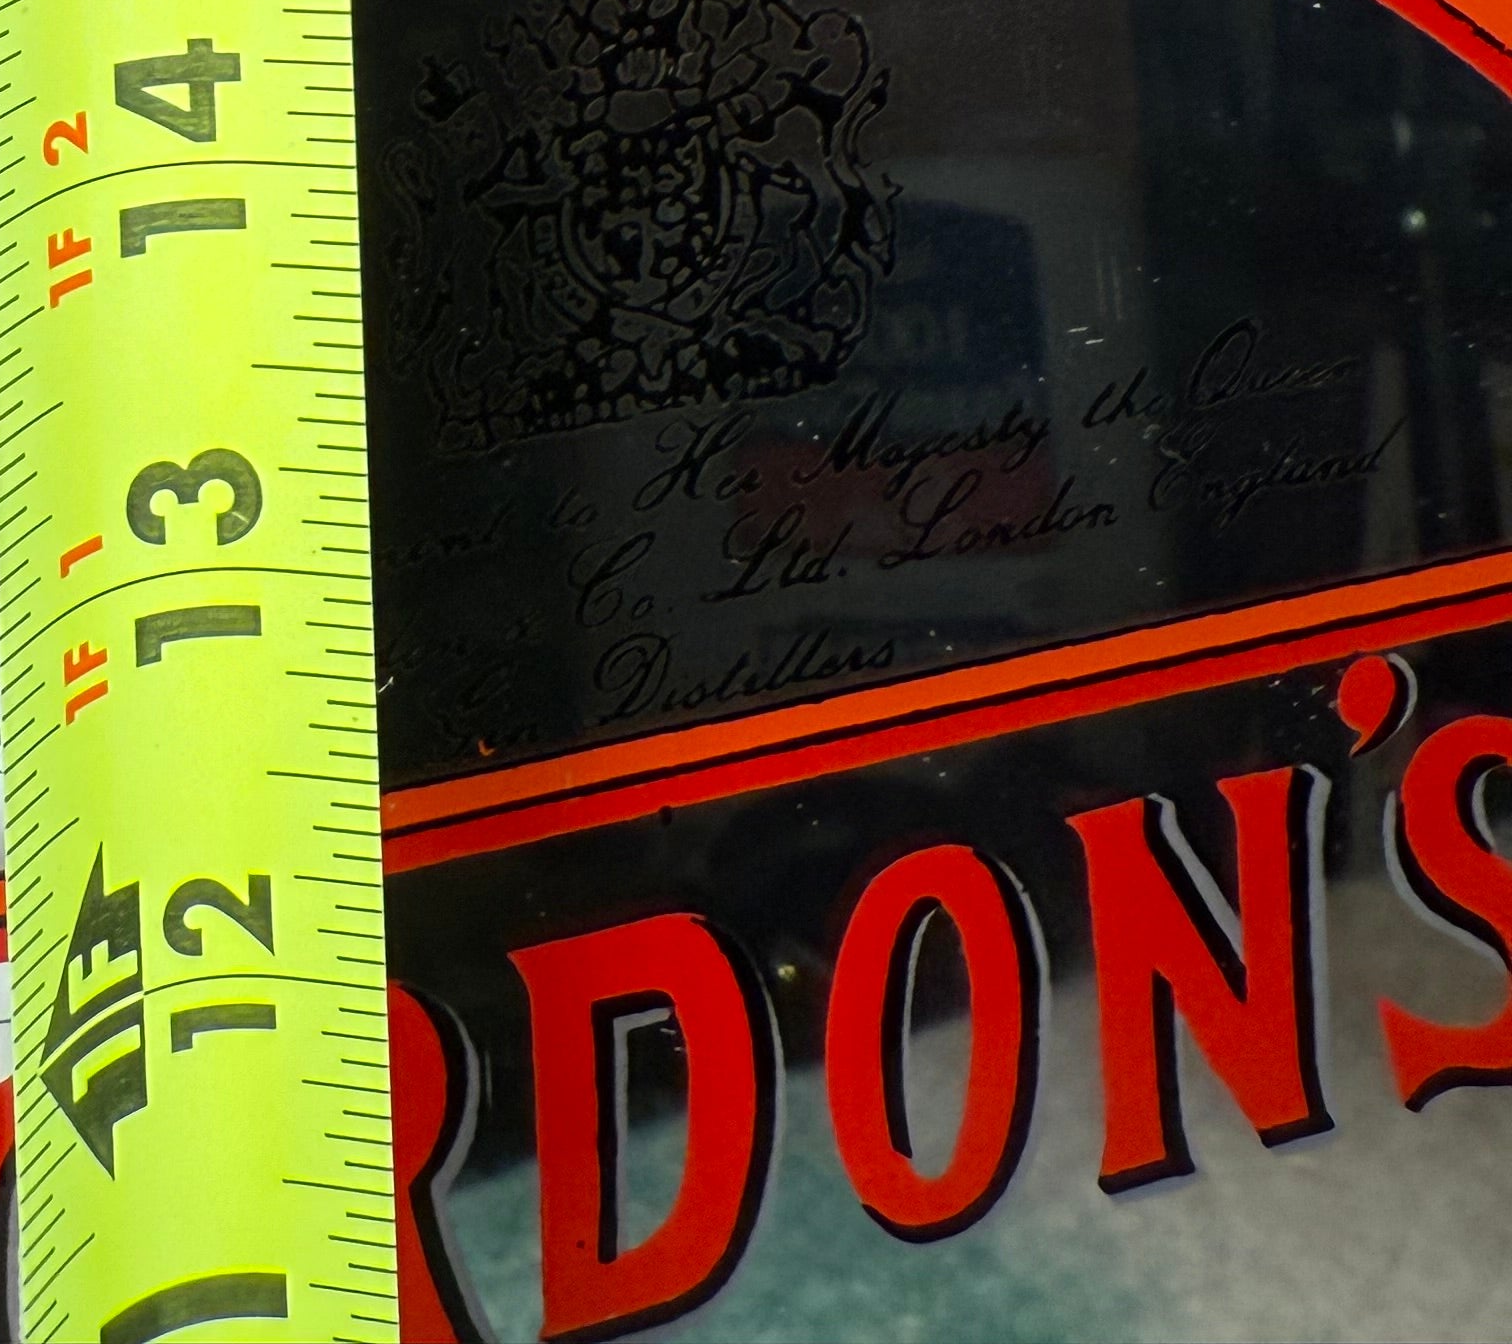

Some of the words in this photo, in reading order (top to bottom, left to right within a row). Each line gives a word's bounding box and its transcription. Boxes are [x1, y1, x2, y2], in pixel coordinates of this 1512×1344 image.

[43, 110, 88, 167] 2
[113, 37, 247, 258] 14
[47, 226, 93, 309] 1F
[791, 386, 1053, 502] Majesty
[60, 534, 103, 579] 1
[126, 447, 263, 668] 13
[567, 530, 673, 629] Co.
[700, 501, 849, 603] Ltd.
[877, 468, 1121, 570] London
[1149, 416, 1410, 537] England
[63, 640, 109, 726] 1F
[592, 626, 896, 727] Distillers
[162, 873, 276, 1053] 12
[68, 947, 143, 1105] 1F
